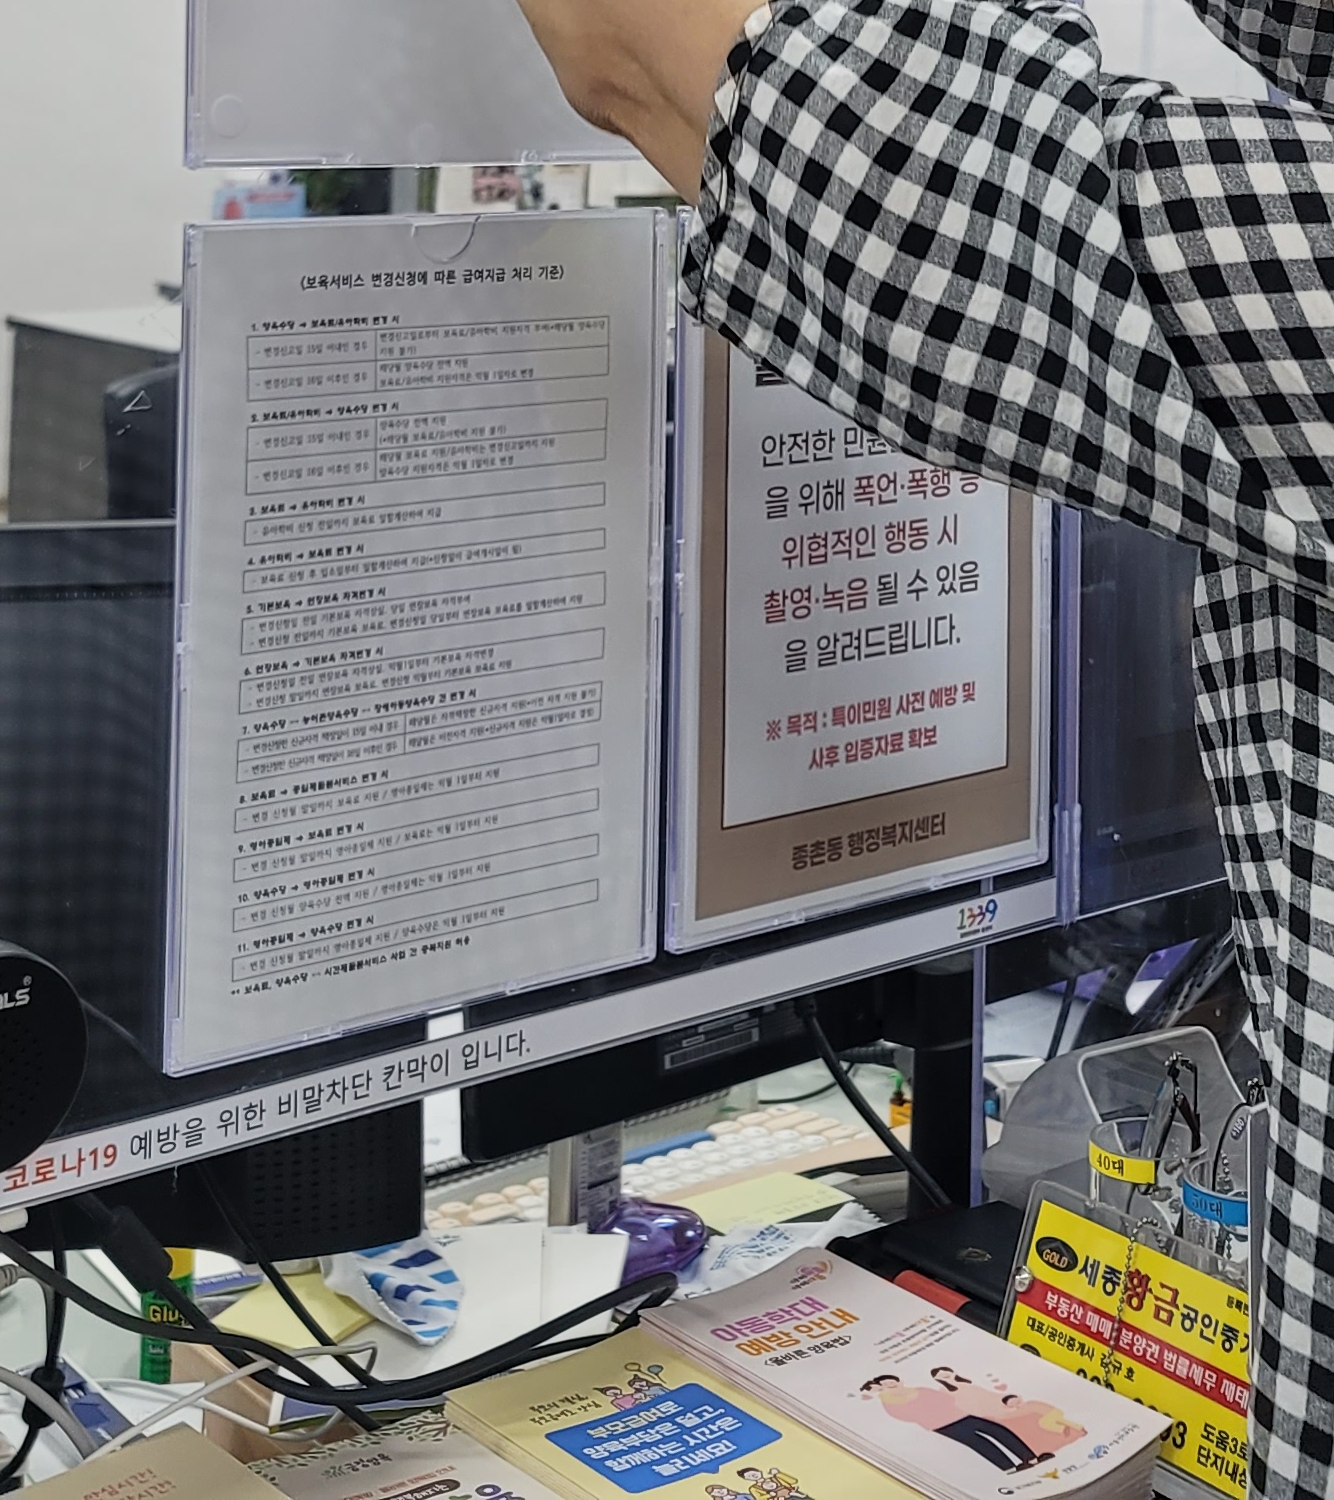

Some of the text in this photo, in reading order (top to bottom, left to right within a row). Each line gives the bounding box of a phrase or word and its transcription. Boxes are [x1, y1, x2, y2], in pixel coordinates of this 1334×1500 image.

[371, 272, 427, 287] 변경신청에
[435, 269, 457, 285] 따른
[462, 268, 506, 284] 급여지급
[511, 265, 533, 282] 처리
[761, 428, 836, 469] 안전한
[765, 485, 789, 519] 을
[798, 478, 846, 514] 위해
[853, 467, 951, 506] 폭언·폭행
[781, 514, 959, 570] 위협적인 행동 시
[764, 560, 980, 625] 촬영·녹음 될 수 있음
[784, 611, 961, 673] 을 알려드립니다.
[786, 681, 976, 736] 목적 특이민원 사전 예방 및
[808, 725, 938, 771] 사후 입증자료 확보
[791, 811, 946, 871] 종촌동 행정복지센터
[956, 898, 998, 931] 1339
[3, 1030, 532, 1193] 코로나19 예방을 위한 비말차단 칸막이 입니다.
[1096, 1152, 1125, 1177] 40대
[1042, 1250, 1068, 1270] GOLD
[149, 1305, 178, 1323] Glu
[710, 1295, 830, 1342] 아동학대
[736, 1330, 801, 1357] 예방
[793, 1307, 860, 1341] 안내
[1026, 1316, 1095, 1359] 대표/공인중개사
[1044, 1290, 1084, 1325] 부동산
[1085, 1310, 1112, 1339] 매매
[1118, 1328, 1160, 1365] 분양권
[1162, 1349, 1218, 1391] 법률세무
[1220, 1378, 1249, 1410] 재테
[582, 1421, 682, 1460] 양육부담은
[586, 1400, 685, 1440] 부모급여로
[603, 1415, 743, 1472] 함께하는 시간은
